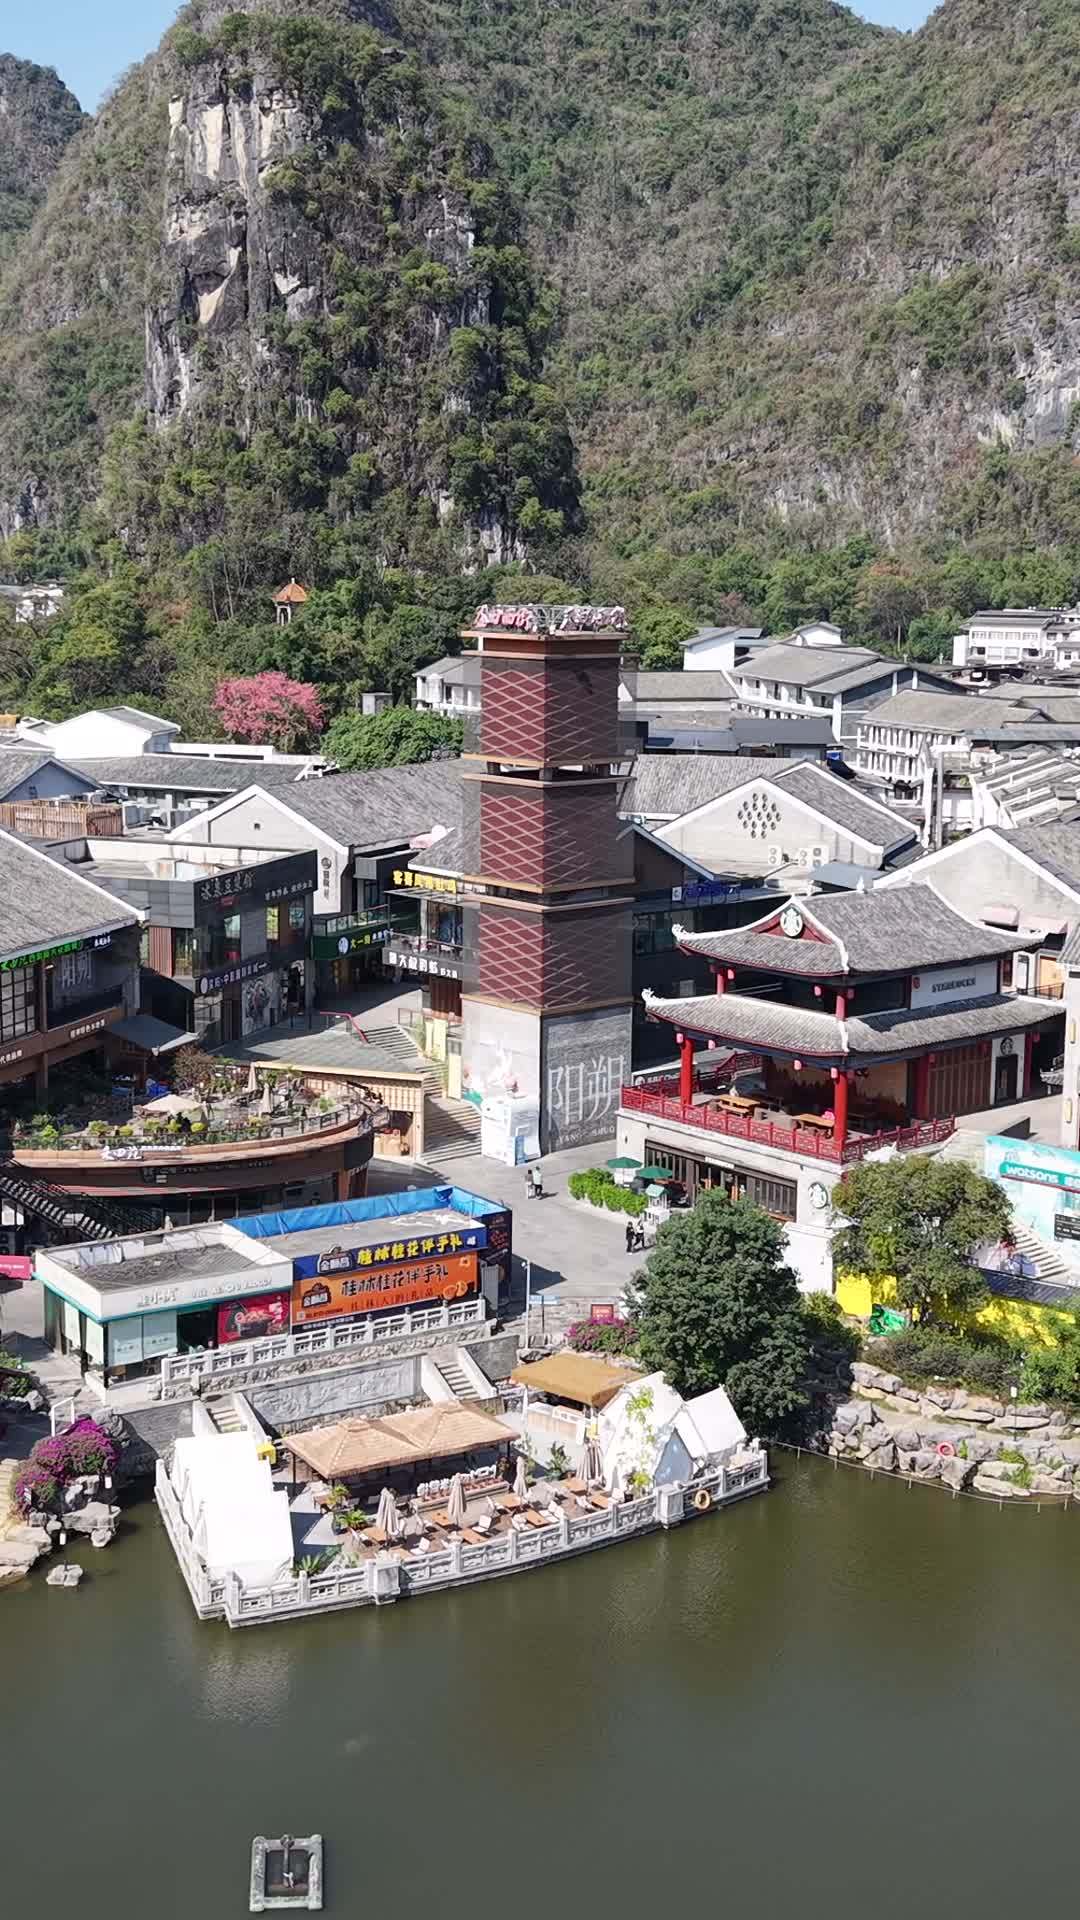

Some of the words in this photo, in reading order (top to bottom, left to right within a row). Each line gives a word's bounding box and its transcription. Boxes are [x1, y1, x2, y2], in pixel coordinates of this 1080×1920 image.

[546, 1054, 624, 1133] 阳朔
[1006, 1165, 1059, 1183] watsons
[357, 1233, 462, 1265] 桂林桂花伴手礼
[342, 1263, 449, 1297] 桂林桂花伴手礼
